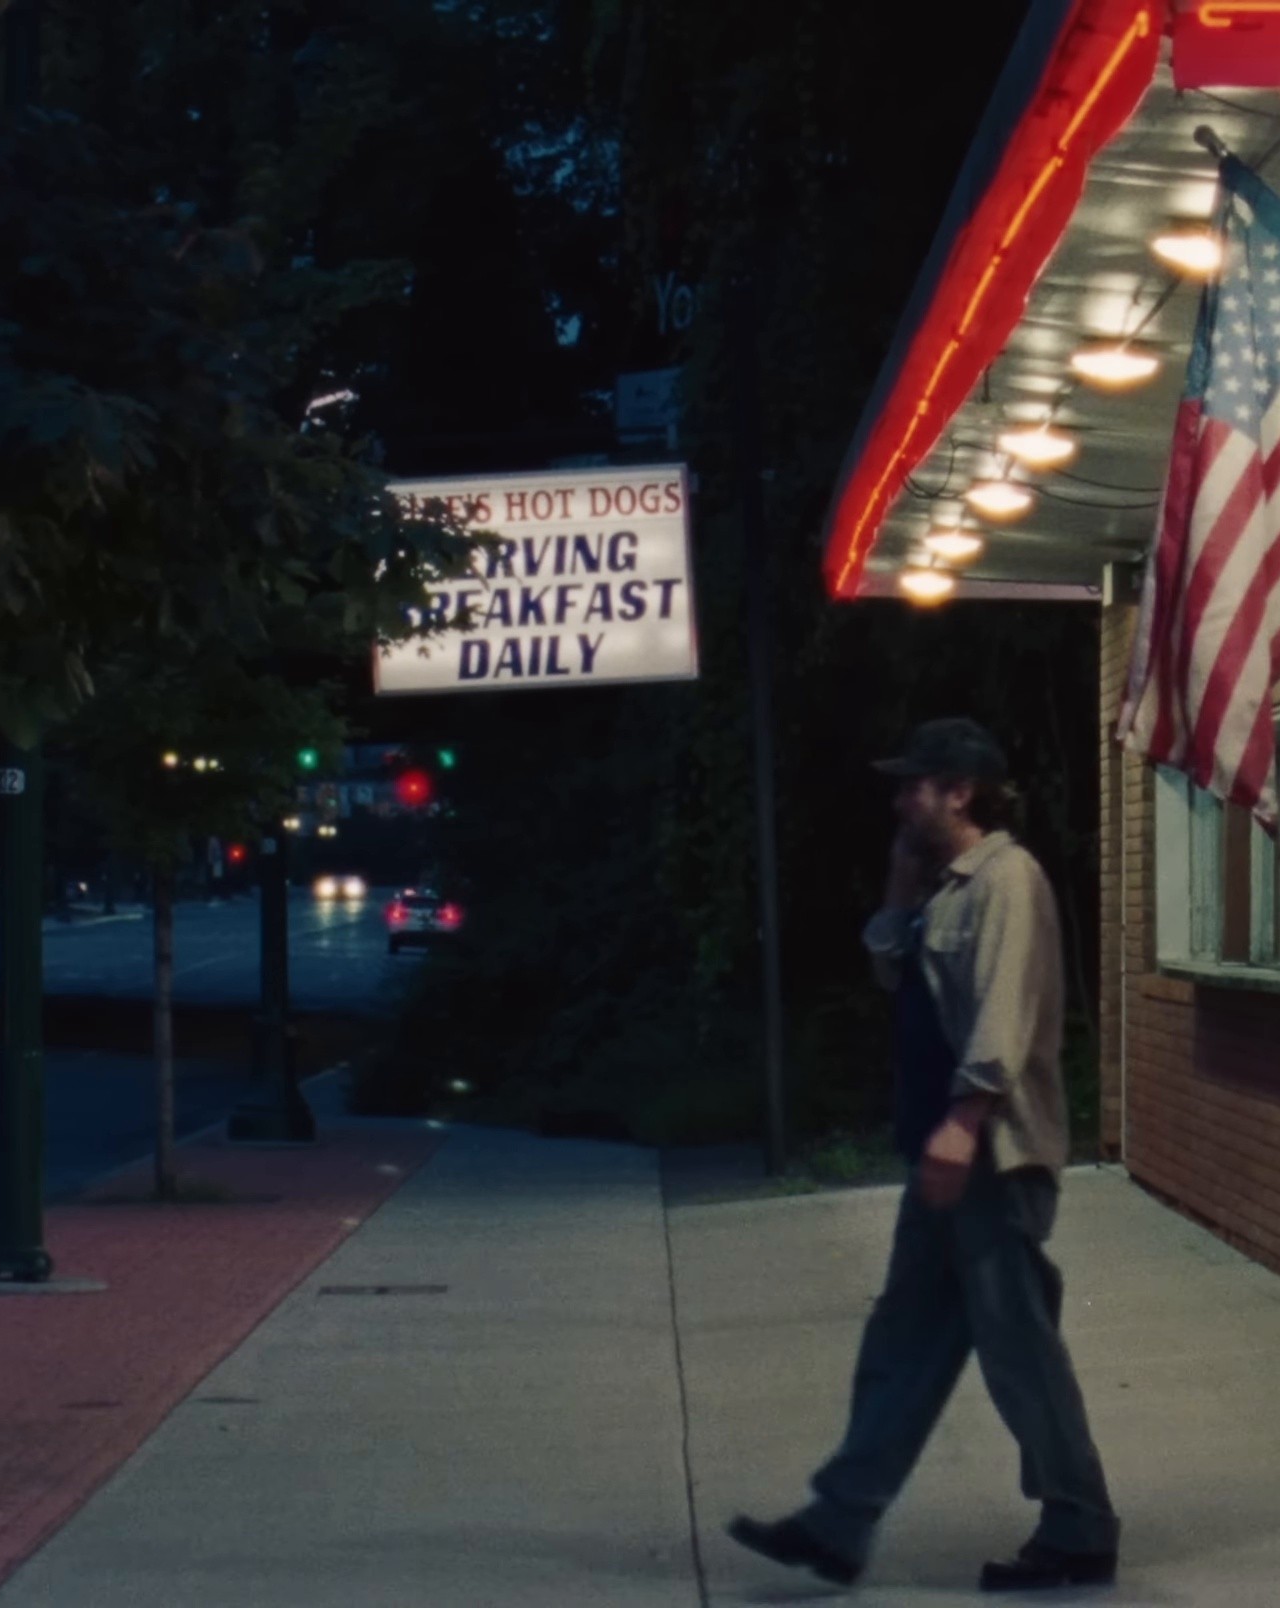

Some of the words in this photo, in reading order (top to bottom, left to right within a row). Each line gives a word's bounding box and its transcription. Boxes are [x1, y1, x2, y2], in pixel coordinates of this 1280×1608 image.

[505, 488, 575, 521] HOT
[588, 482, 681, 516] DOGS
[432, 530, 639, 580] RVING
[457, 632, 605, 681] DAILY
